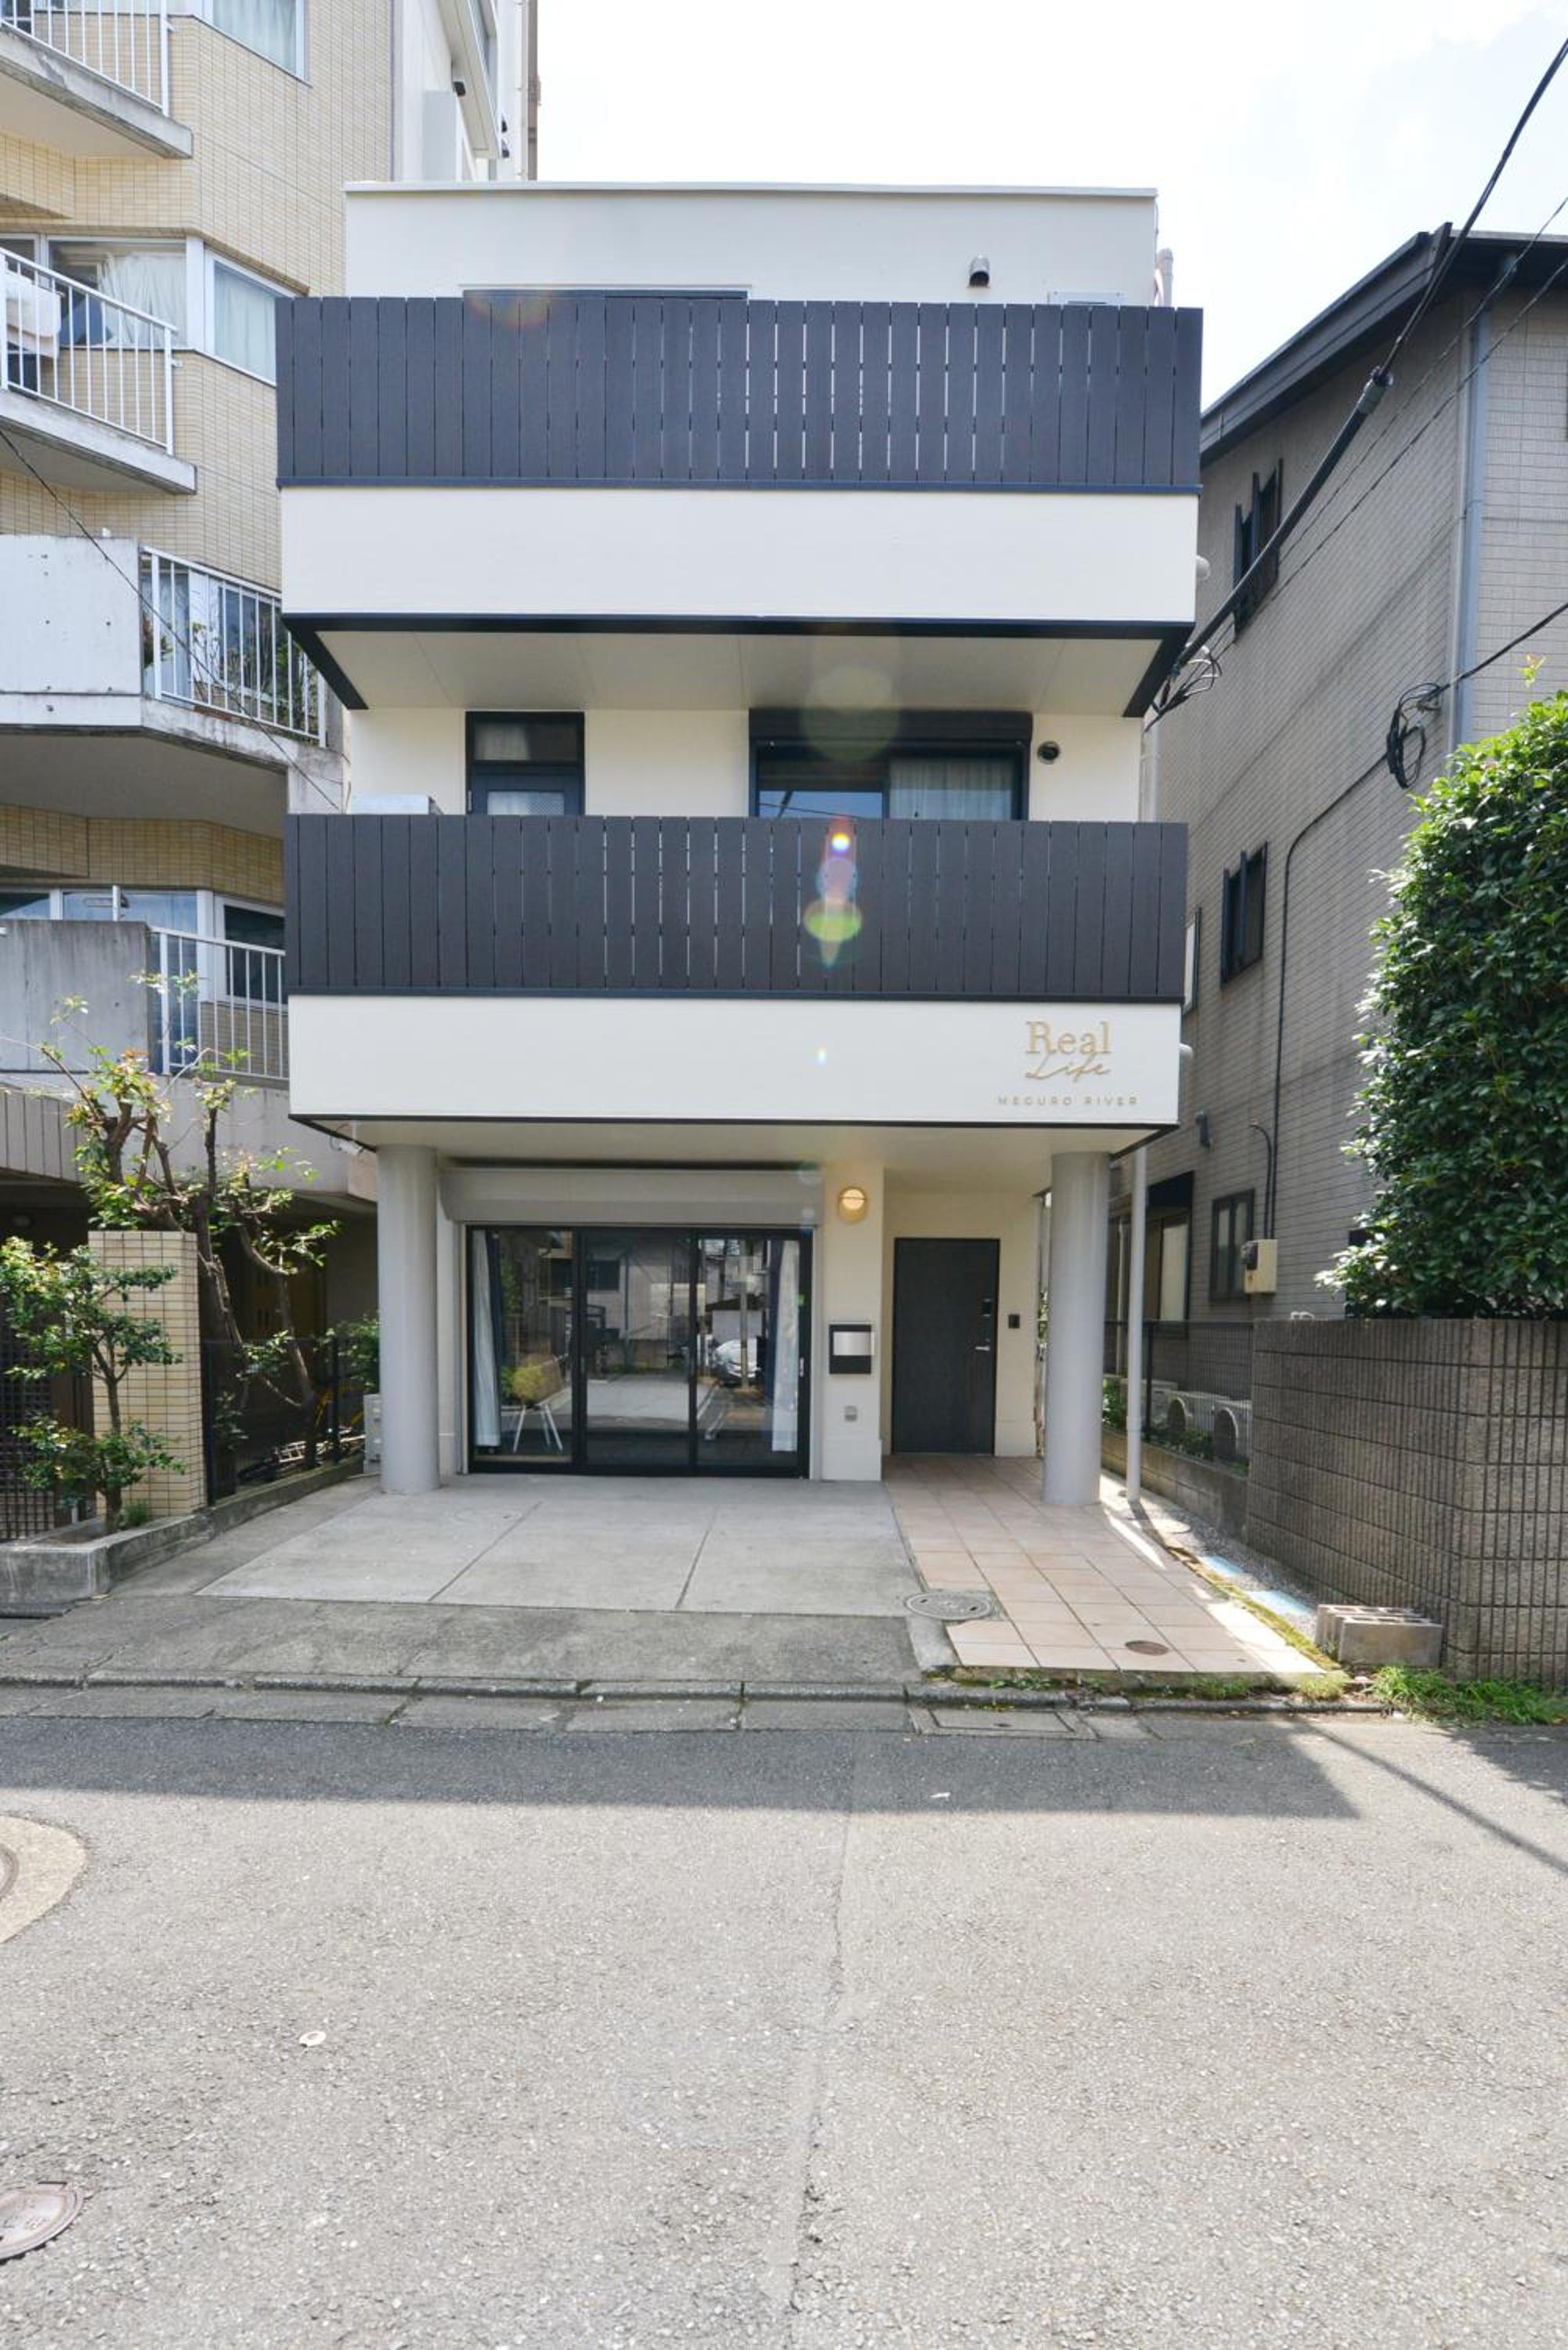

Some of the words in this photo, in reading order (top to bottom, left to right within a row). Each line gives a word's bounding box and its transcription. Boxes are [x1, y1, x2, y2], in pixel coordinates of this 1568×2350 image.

[1025, 1020, 1112, 1054] Real
[1025, 1052, 1111, 1083] Life
[997, 1096, 1073, 1105] MEGURO
[1084, 1096, 1138, 1105] RIVER
